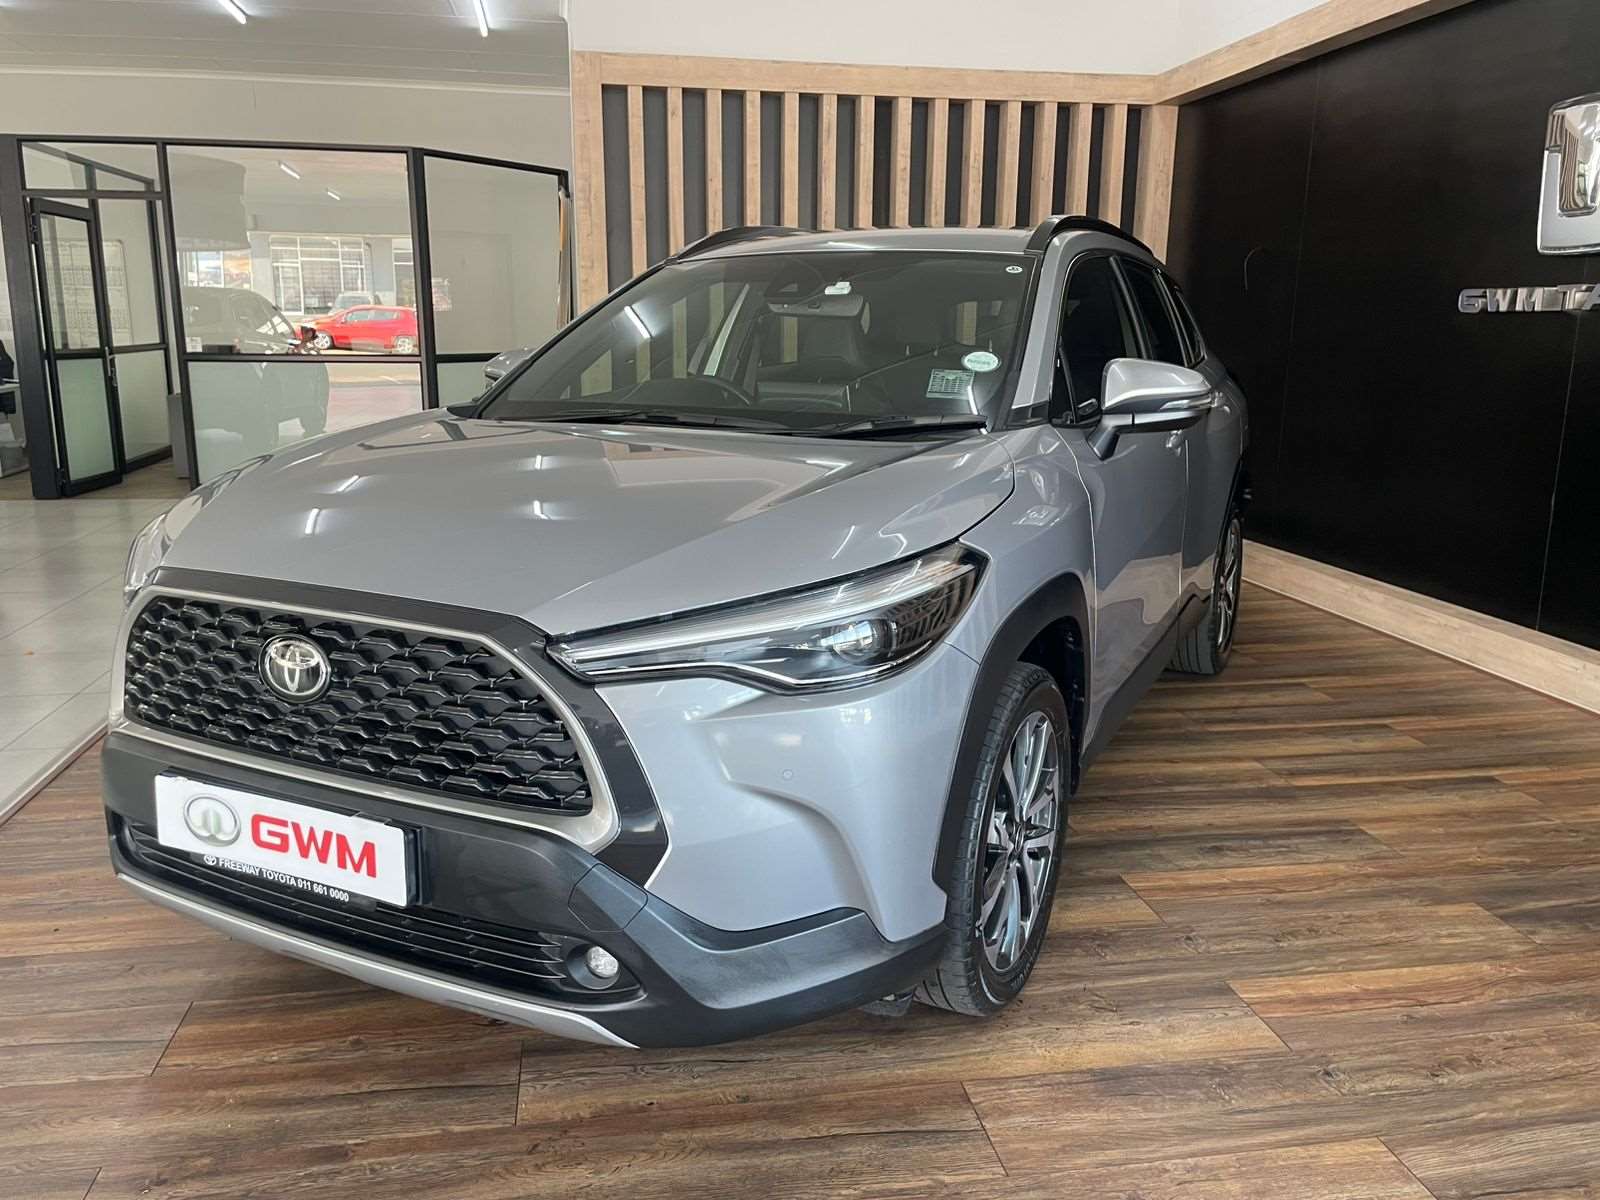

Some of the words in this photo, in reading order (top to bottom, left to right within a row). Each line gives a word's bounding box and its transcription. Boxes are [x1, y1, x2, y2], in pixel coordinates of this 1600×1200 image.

[1458, 287, 1544, 313] GWM
[251, 813, 377, 878] GWM
[219, 859, 261, 876] FREEWAY
[262, 868, 297, 887] TOYOTA
[297, 878, 312, 891] 011
[313, 883, 328, 896] 661
[329, 888, 350, 902] 0000
